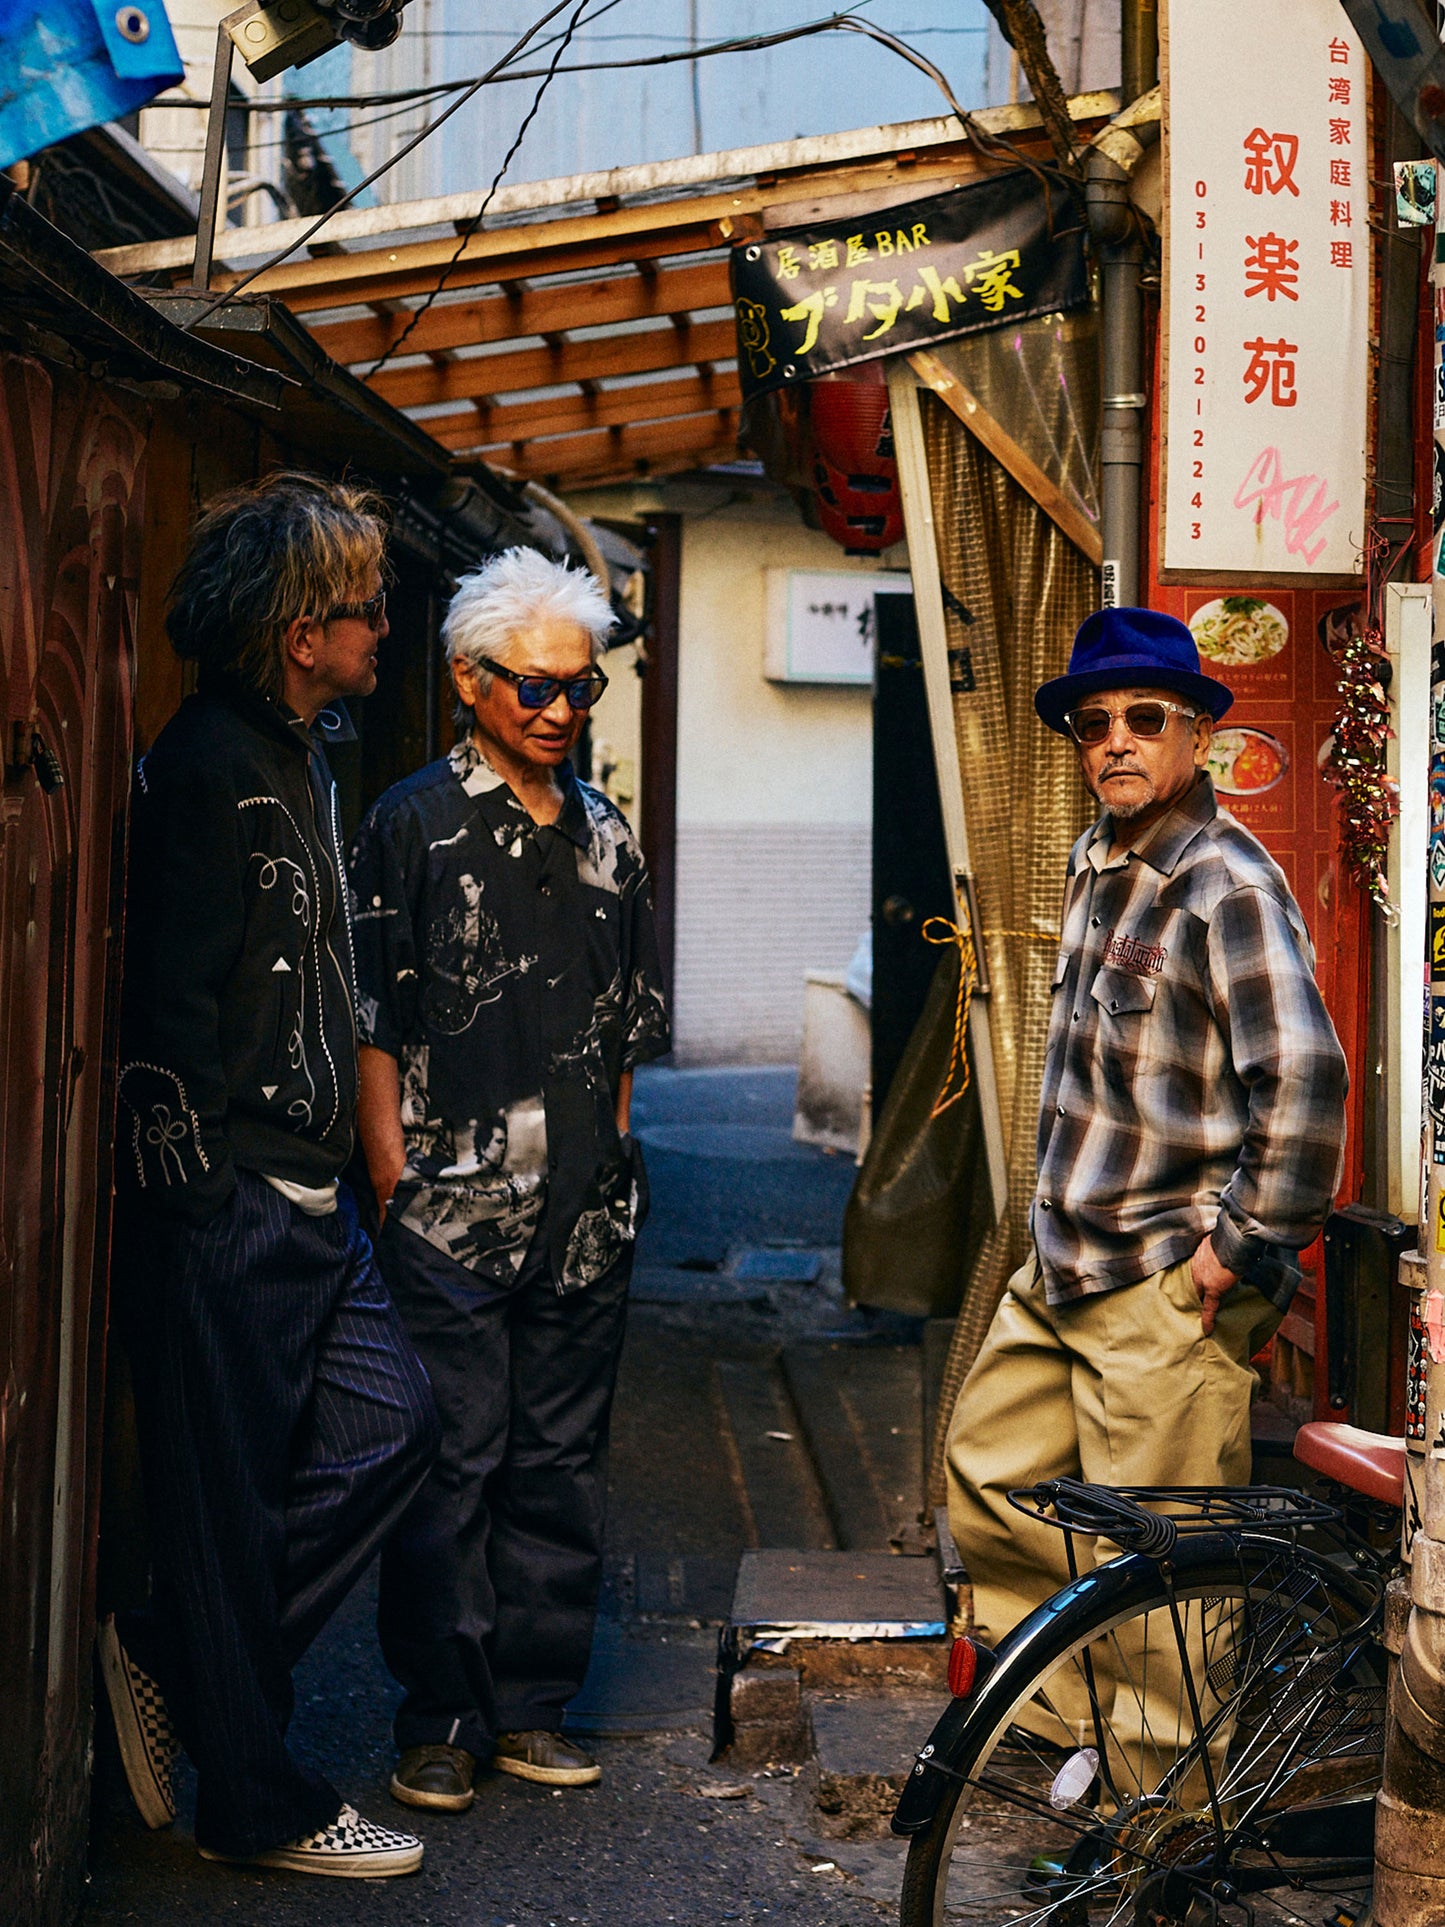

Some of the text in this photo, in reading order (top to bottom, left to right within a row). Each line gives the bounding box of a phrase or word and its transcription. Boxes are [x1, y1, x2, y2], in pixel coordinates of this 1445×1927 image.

[1242, 127, 1300, 408] 叙楽苑
[1328, 37, 1353, 269] 台湾家庭料理
[779, 248, 1024, 355] ブタ小家
